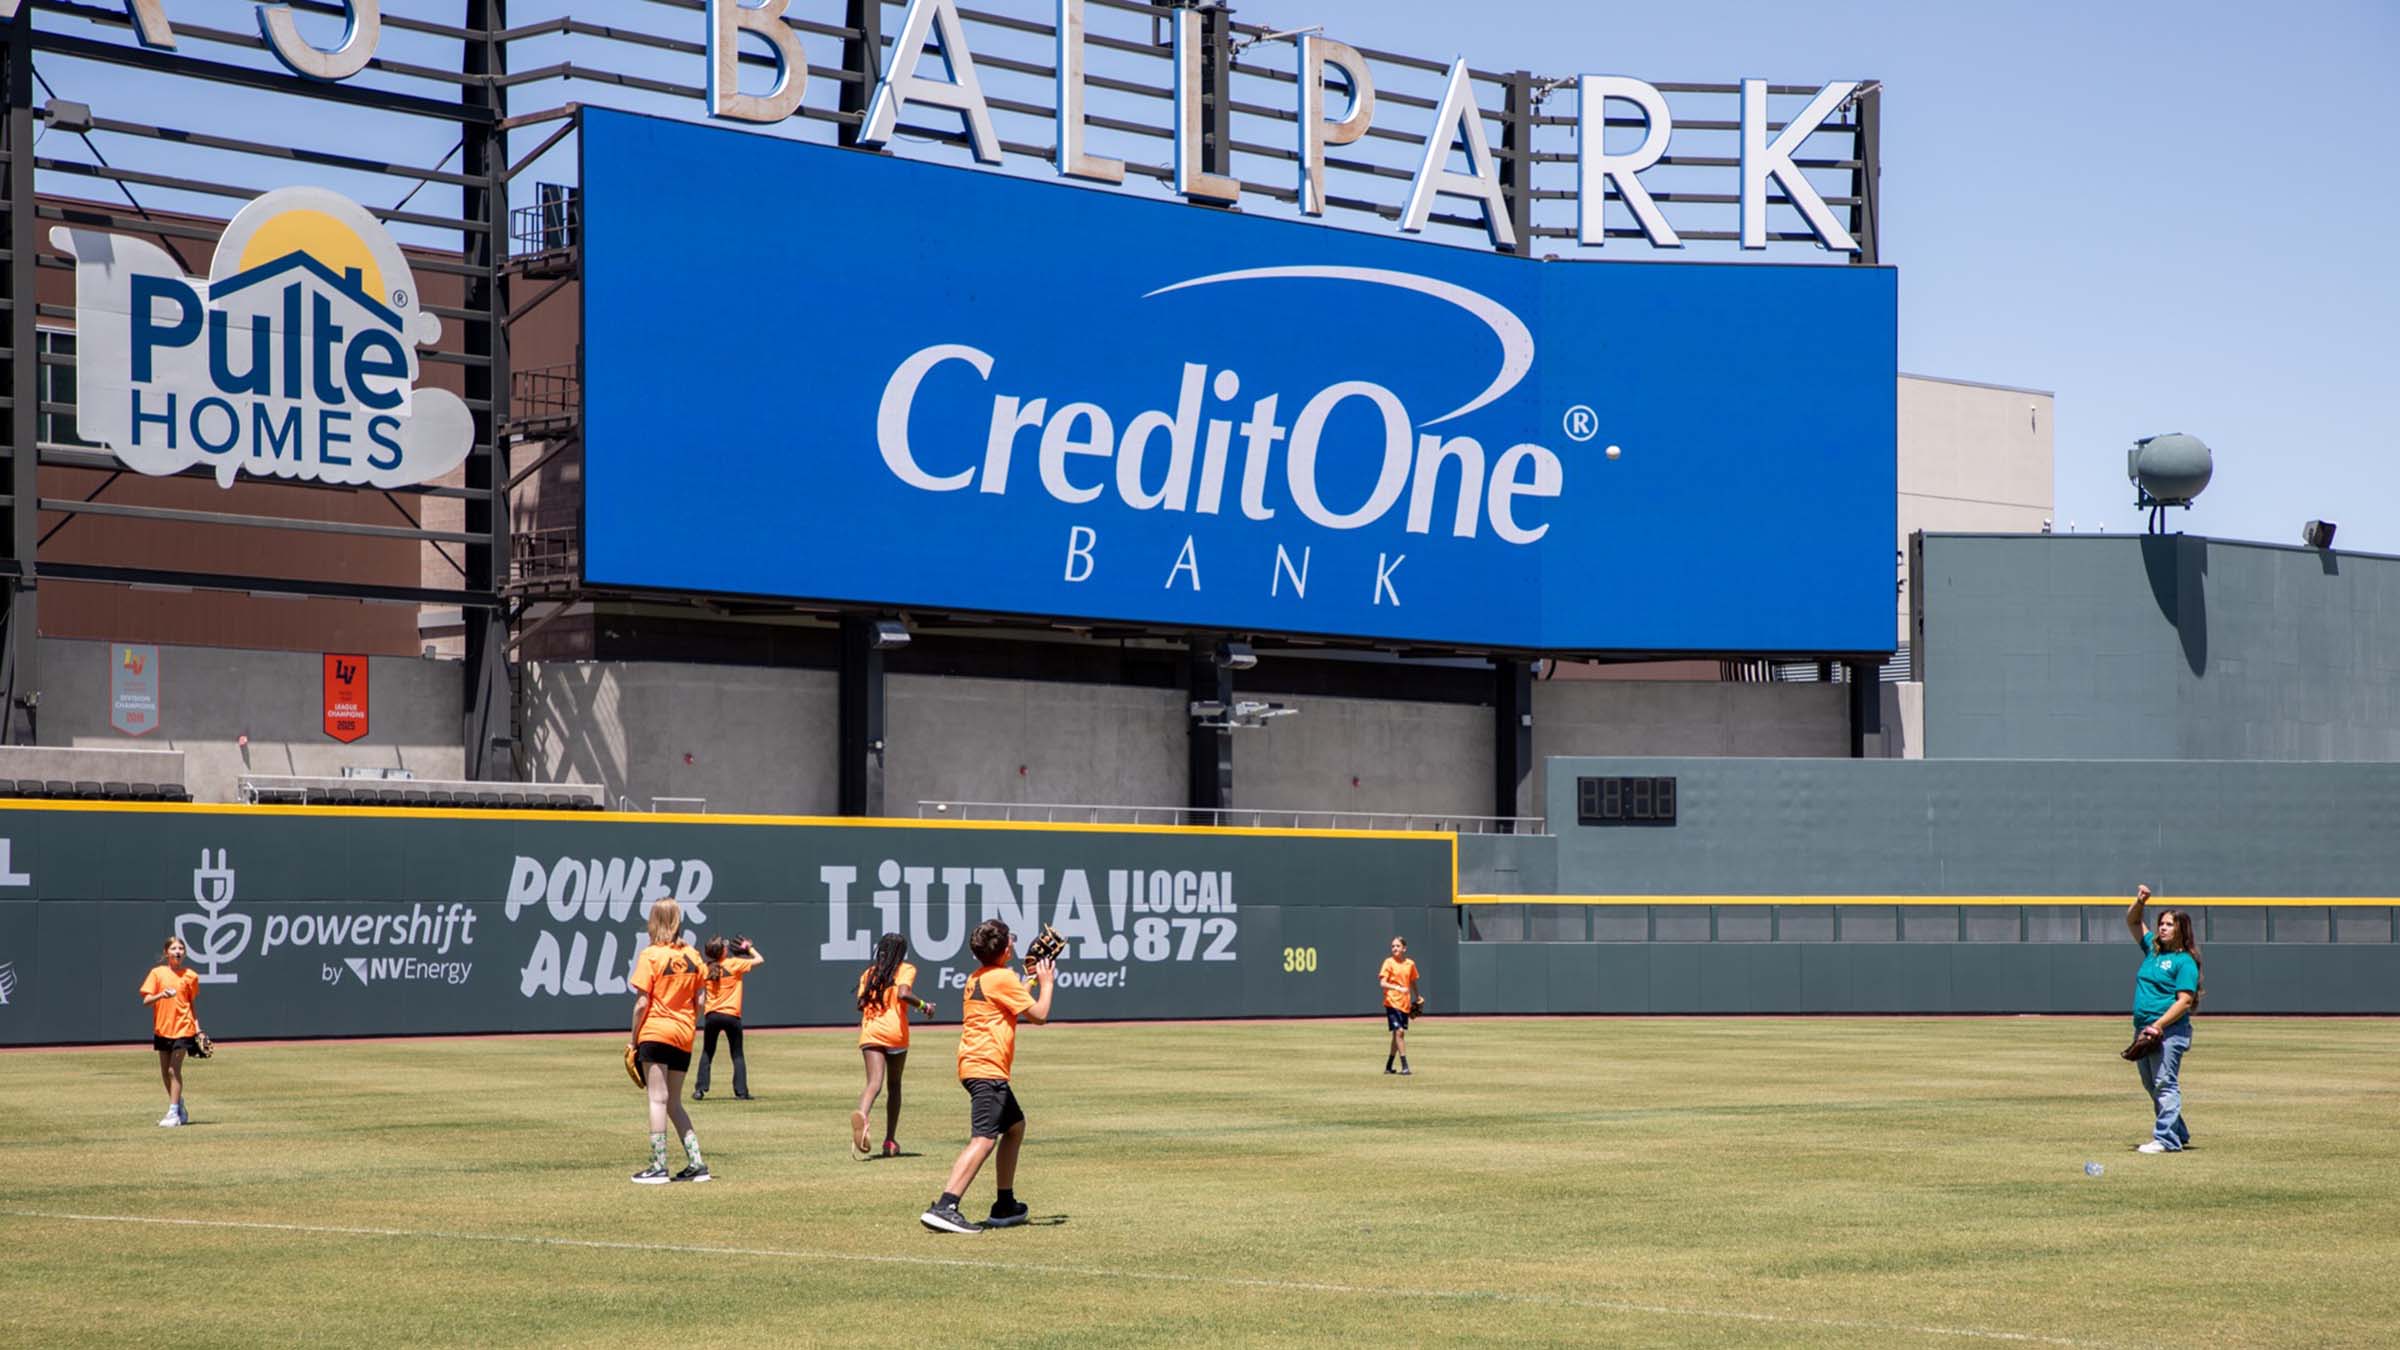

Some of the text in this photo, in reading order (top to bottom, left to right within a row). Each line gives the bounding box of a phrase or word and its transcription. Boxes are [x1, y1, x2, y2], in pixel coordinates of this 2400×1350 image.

[706, 0, 1862, 252] BALLPARK
[131, 273, 408, 410] Pulte
[131, 389, 403, 470] HOMES
[1064, 526, 1406, 606] BANK
[336, 660, 356, 684] LV
[327, 710, 365, 719] CHAMPIONS
[505, 856, 713, 924] POWER
[1133, 869, 1238, 914] LOCAL
[261, 903, 477, 956] powershift
[1133, 917, 1238, 962] 872
[322, 957, 473, 985] by NVEnergy
[520, 930, 697, 998] ALL
[1054, 966, 1126, 988] ower!
[1284, 947, 1318, 972] 380
